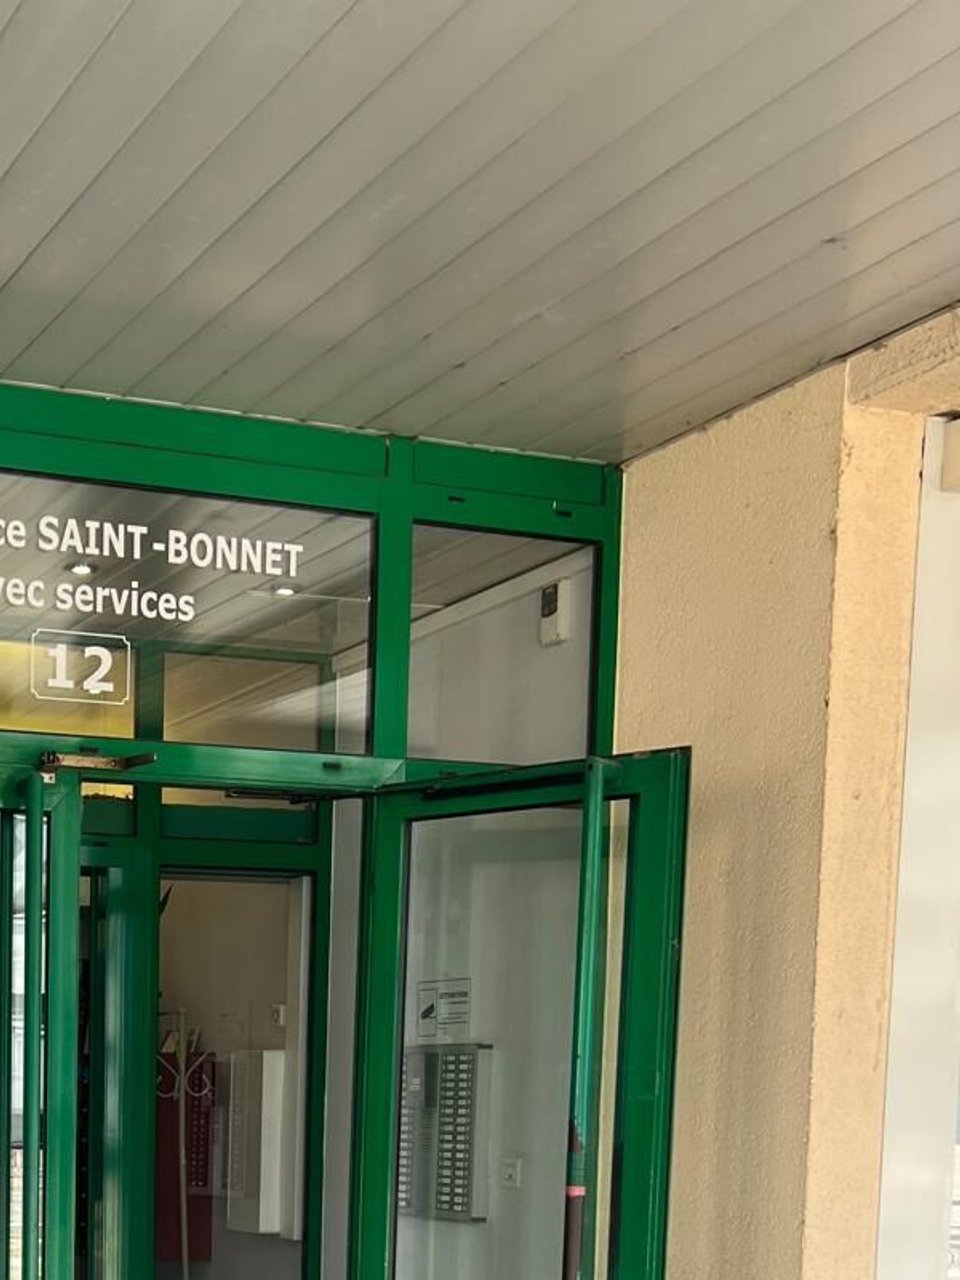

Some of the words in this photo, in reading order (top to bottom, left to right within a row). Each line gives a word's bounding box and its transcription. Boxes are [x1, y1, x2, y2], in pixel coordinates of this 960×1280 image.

[39, 514, 304, 578] SAINT-BONNET
[56, 581, 195, 623] services
[47, 643, 115, 694] 12
